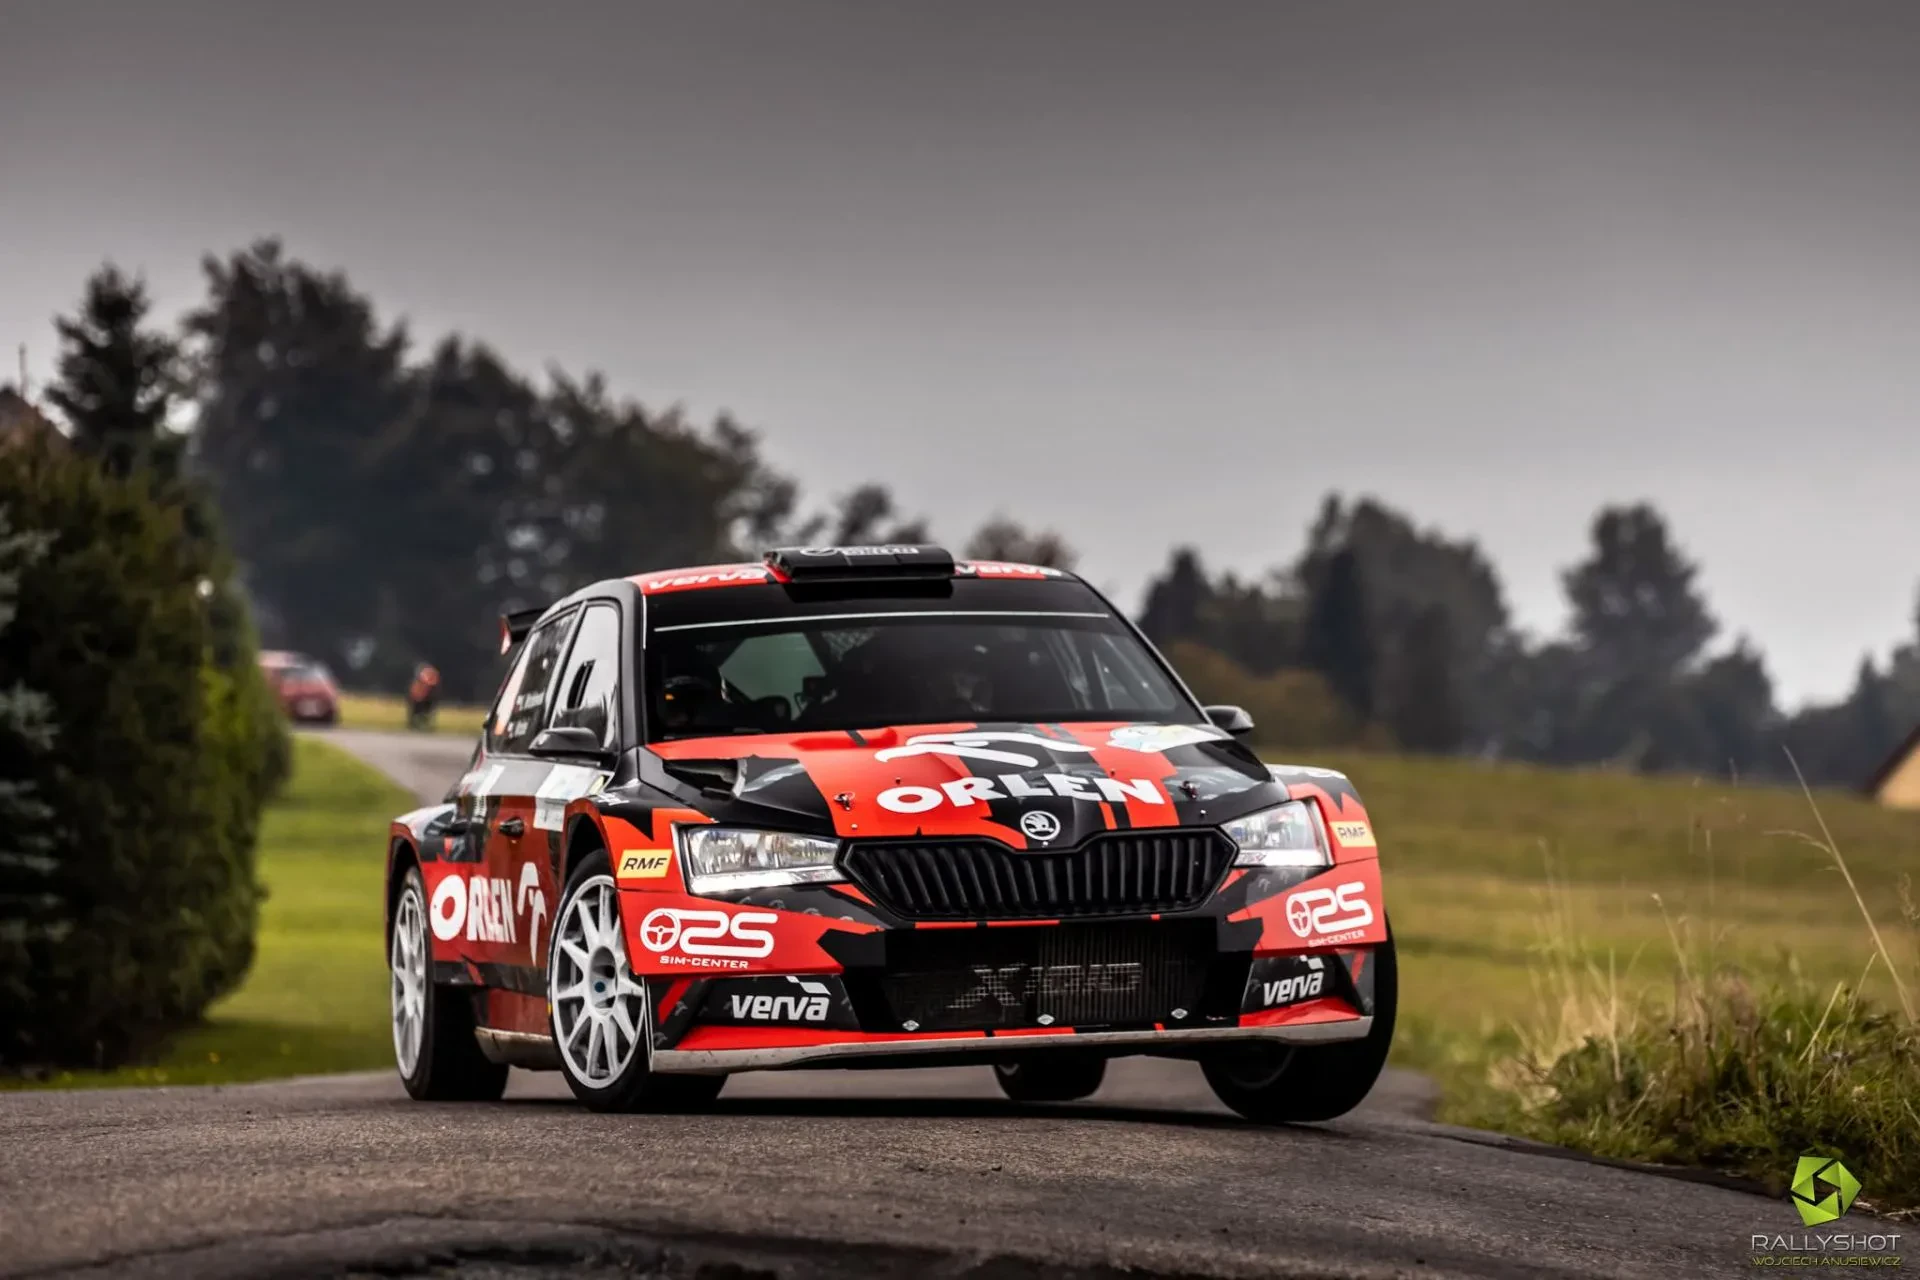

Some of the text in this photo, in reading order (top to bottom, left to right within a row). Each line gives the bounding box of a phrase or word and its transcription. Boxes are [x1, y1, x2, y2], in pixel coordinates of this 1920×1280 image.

[877, 773, 1165, 814] ORLEN
[1338, 826, 1366, 840] RMF
[622, 856, 669, 872] RMF
[429, 873, 517, 944] ORLEN
[659, 955, 749, 970] SIM-CENTER
[1263, 971, 1324, 1007] verva
[731, 993, 830, 1021] verva
